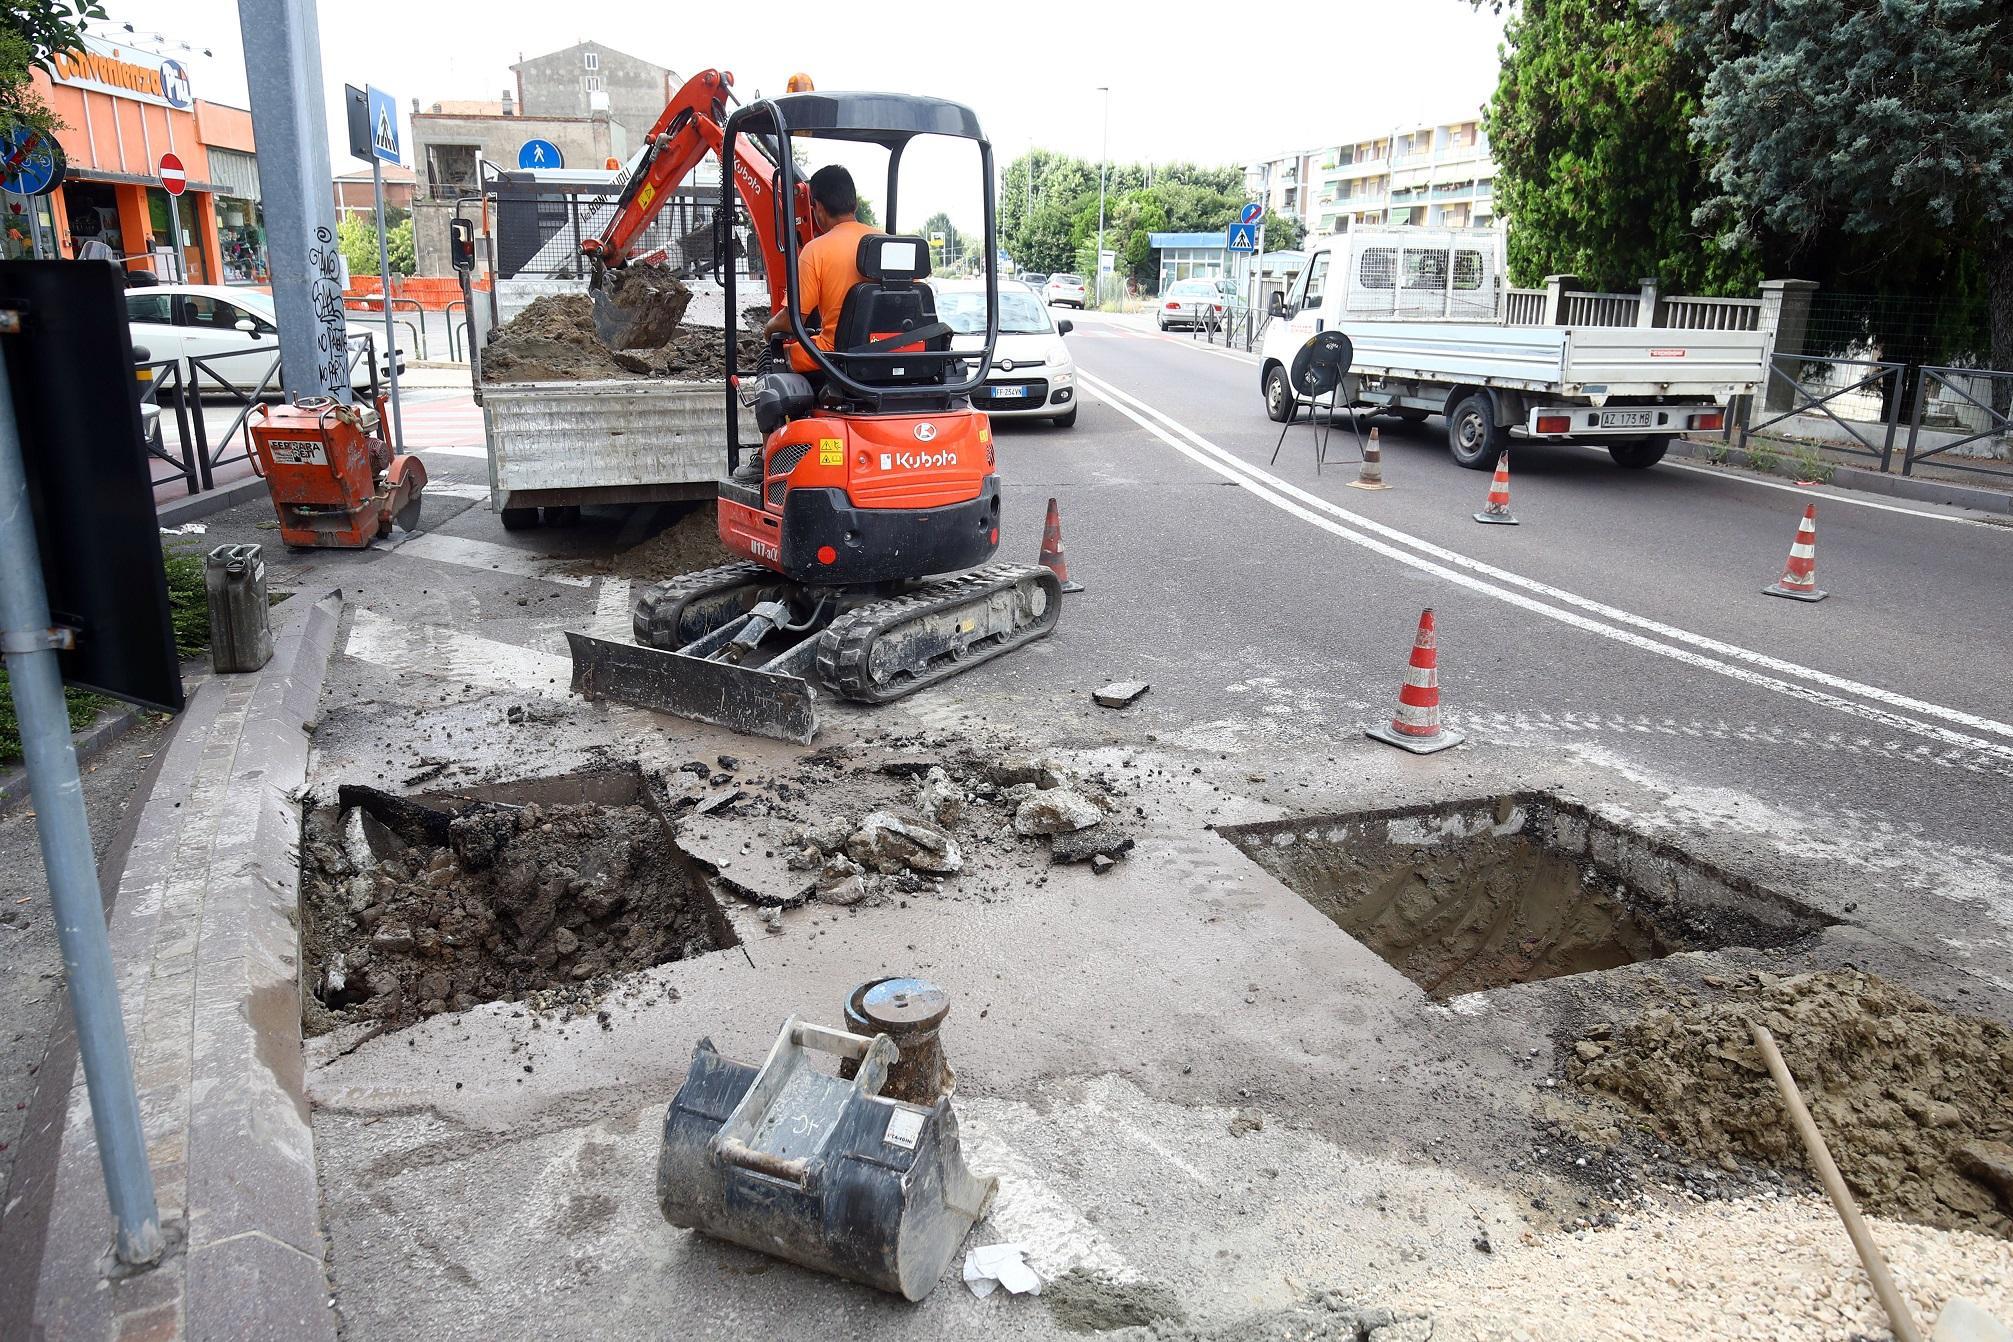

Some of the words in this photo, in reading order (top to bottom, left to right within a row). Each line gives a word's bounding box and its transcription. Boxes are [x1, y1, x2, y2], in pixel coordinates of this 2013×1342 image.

[53, 44, 162, 97] Convenienza
[733, 155, 761, 195] Kubota
[1604, 413, 1616, 425] AZ
[1620, 413, 1638, 425] 173
[1639, 413, 1650, 426] MB
[895, 449, 958, 469] Kubota
